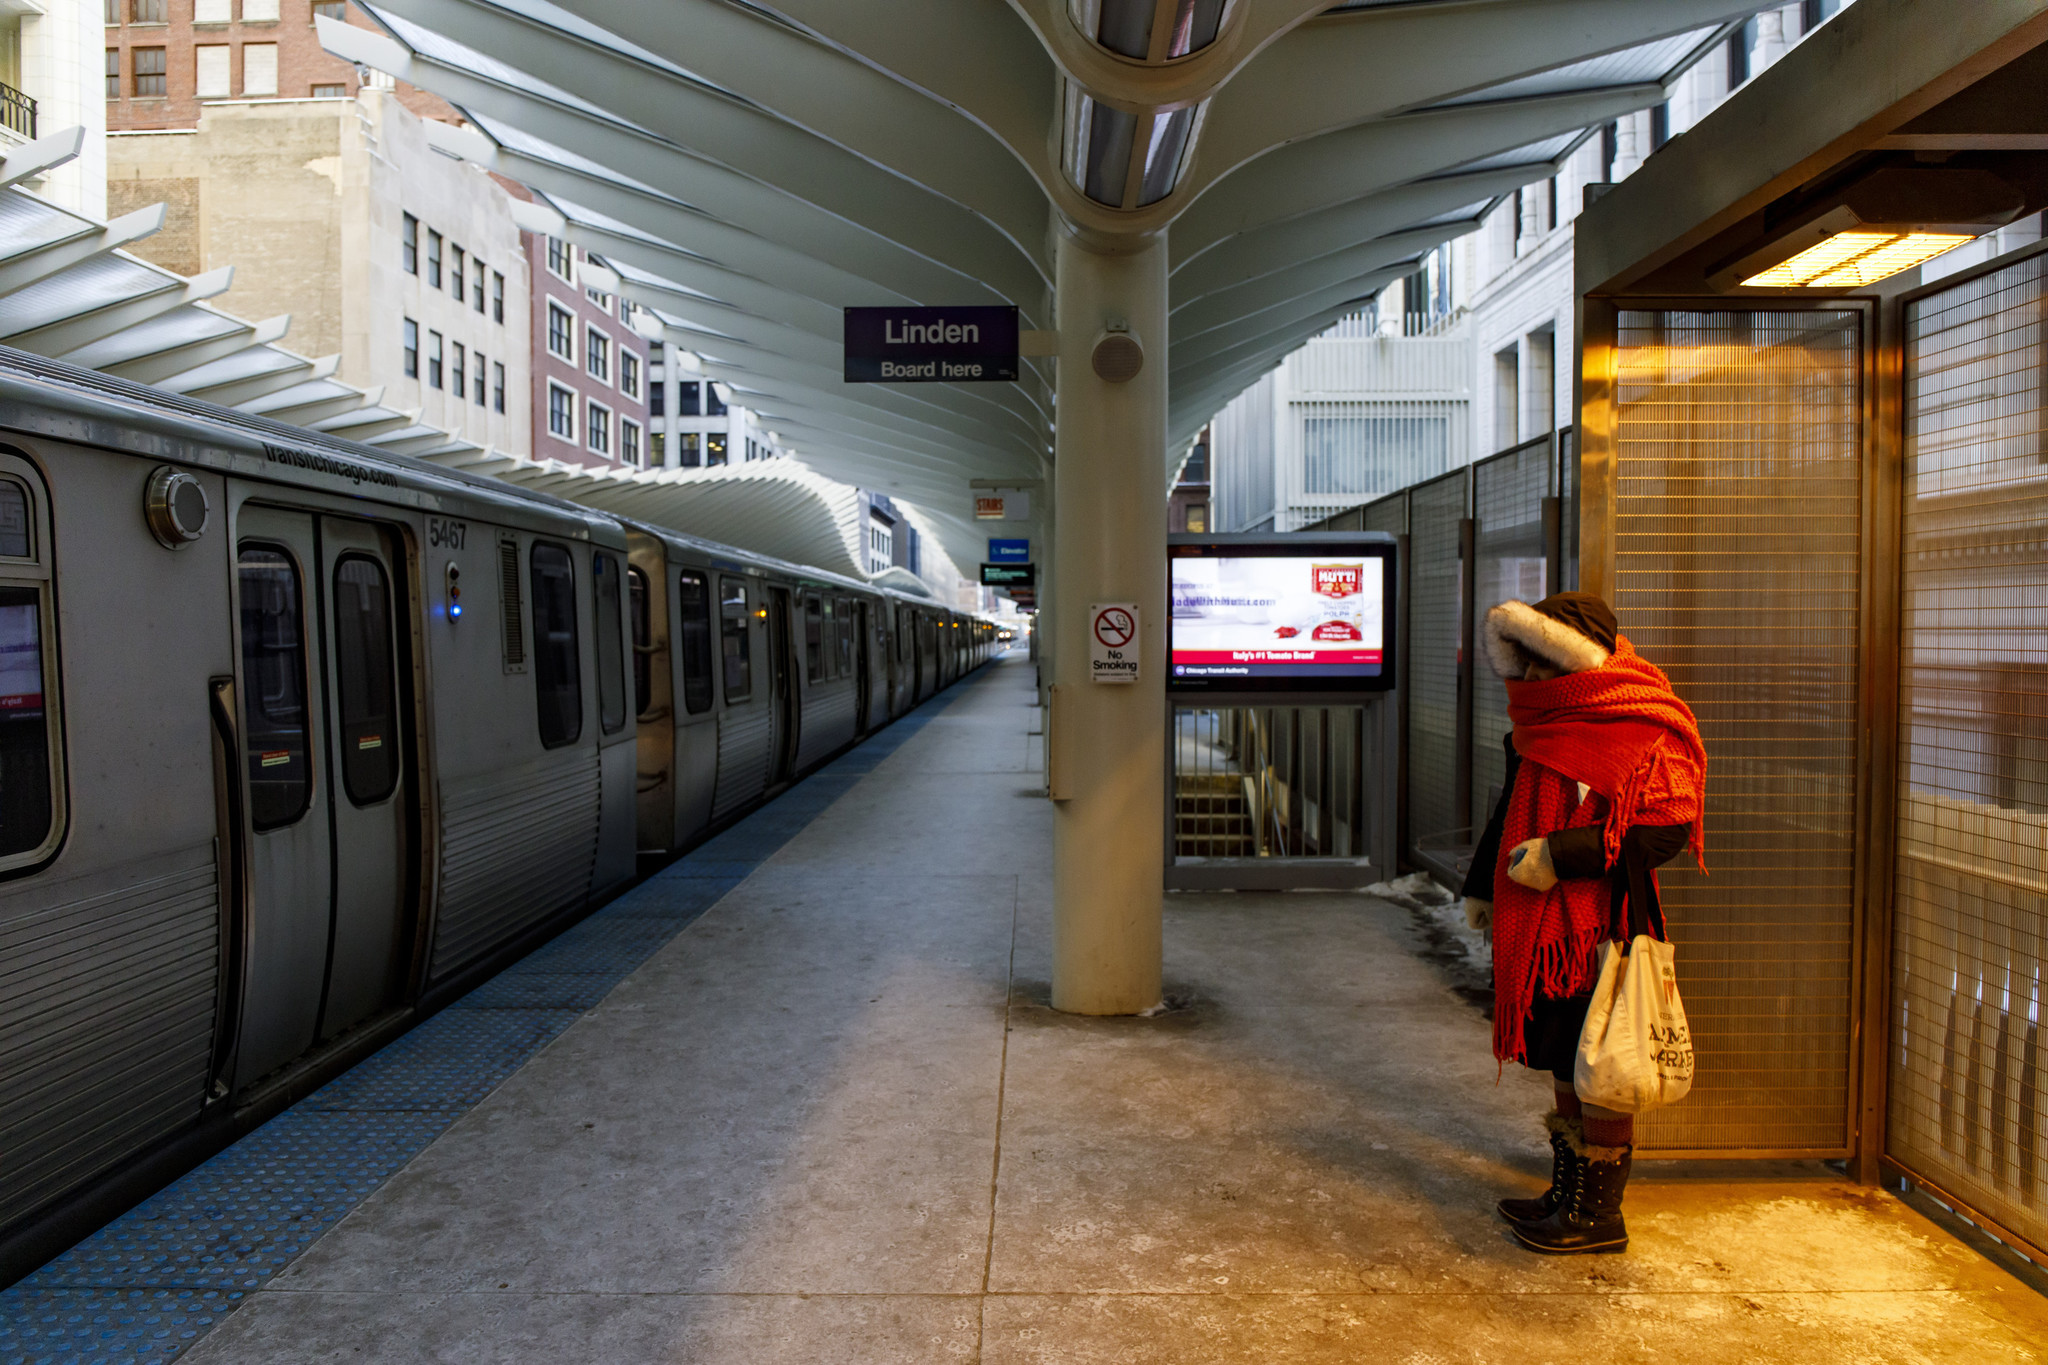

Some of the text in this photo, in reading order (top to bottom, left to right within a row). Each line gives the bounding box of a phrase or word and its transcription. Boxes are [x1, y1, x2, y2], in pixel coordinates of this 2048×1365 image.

[885, 319, 979, 344] Linden
[881, 361, 983, 377] Board here
[261, 441, 398, 488] transitchicago.com
[976, 498, 1004, 511] STAIRS
[429, 517, 467, 550] 5467
[1318, 569, 1356, 582] MUTTI
[1108, 650, 1123, 659] No
[1266, 651, 1292, 660] Tomato
[1093, 660, 1137, 672] Smoking
[1225, 667, 1249, 675] Authority
